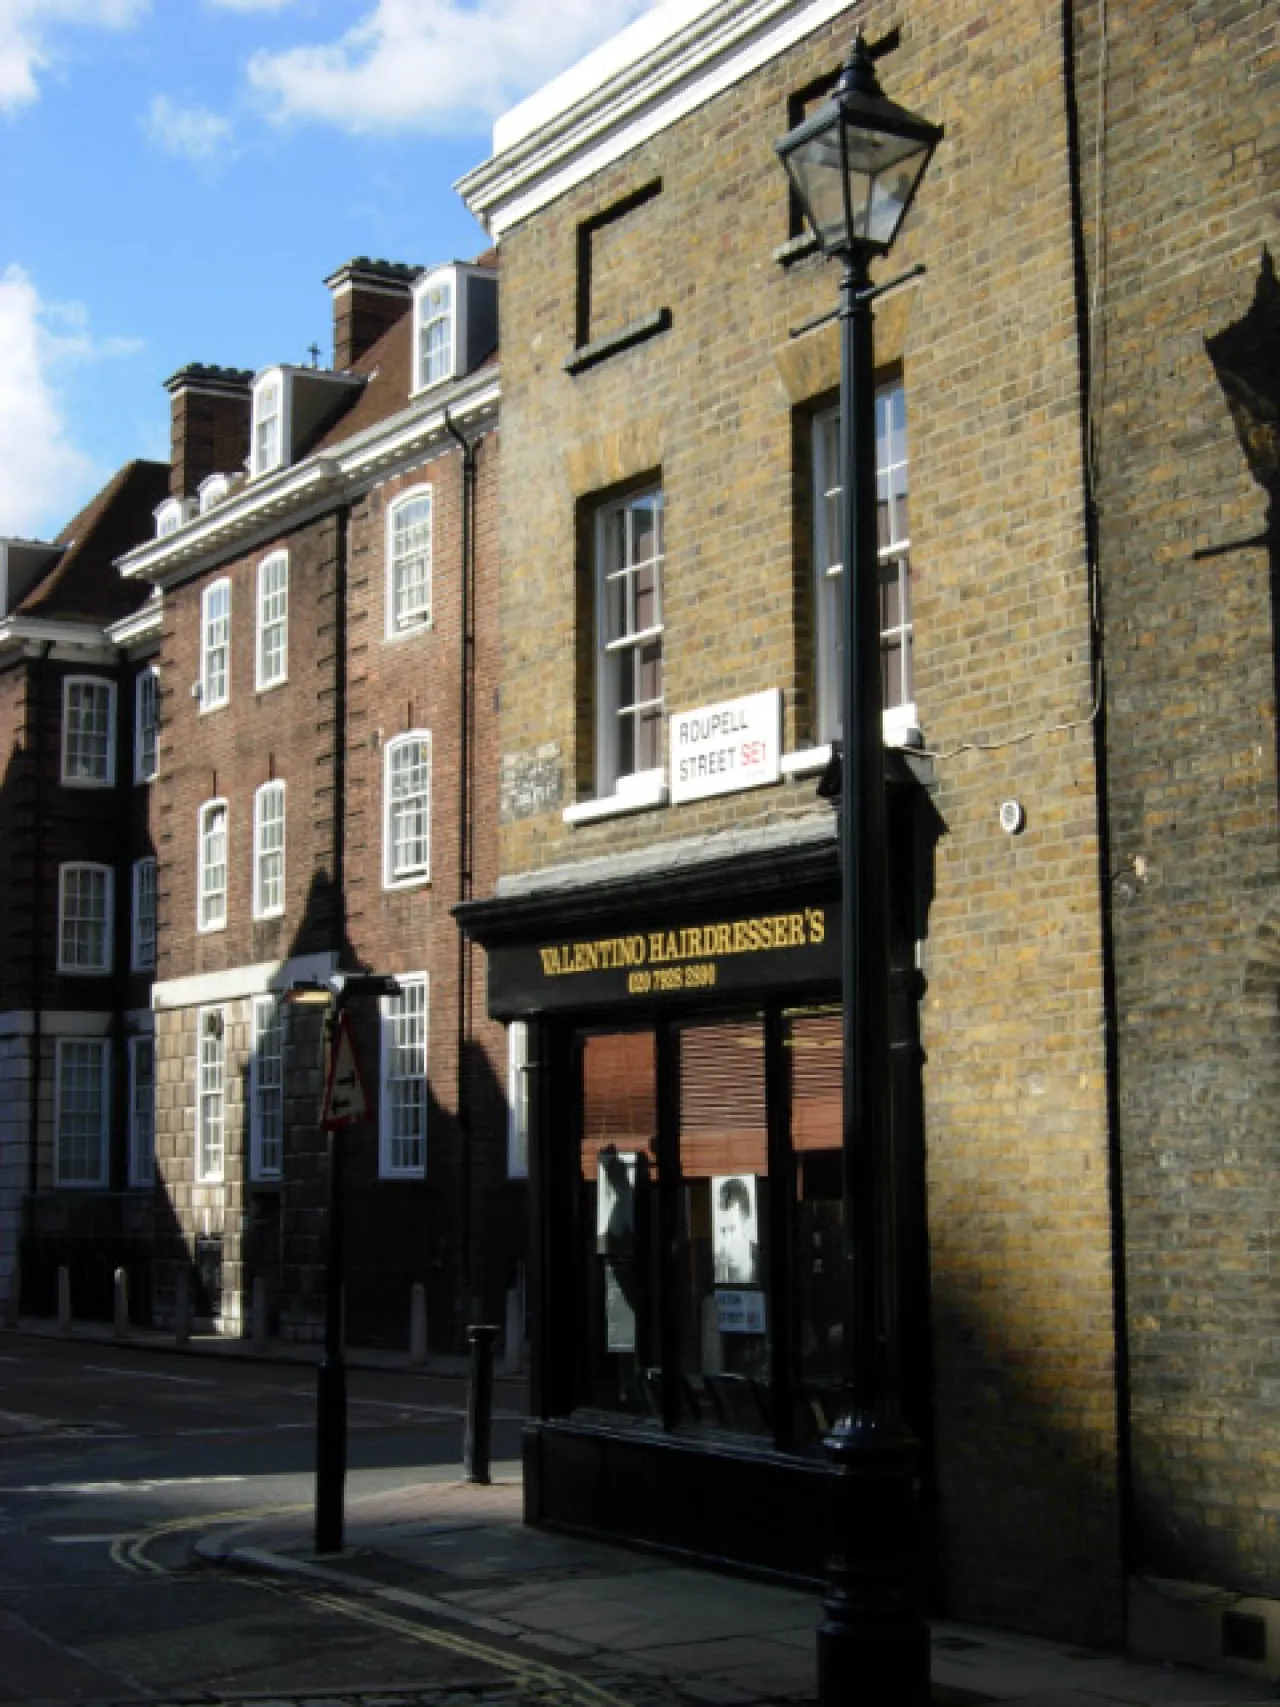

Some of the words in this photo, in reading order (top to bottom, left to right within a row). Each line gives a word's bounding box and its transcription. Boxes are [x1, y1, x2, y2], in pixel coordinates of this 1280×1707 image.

[679, 709, 749, 745] ROUPELL
[679, 747, 736, 782] STREET
[741, 739, 766, 767] SE1
[540, 935, 646, 976] VALENTINO
[648, 907, 825, 964] HAIRDRESSER'S
